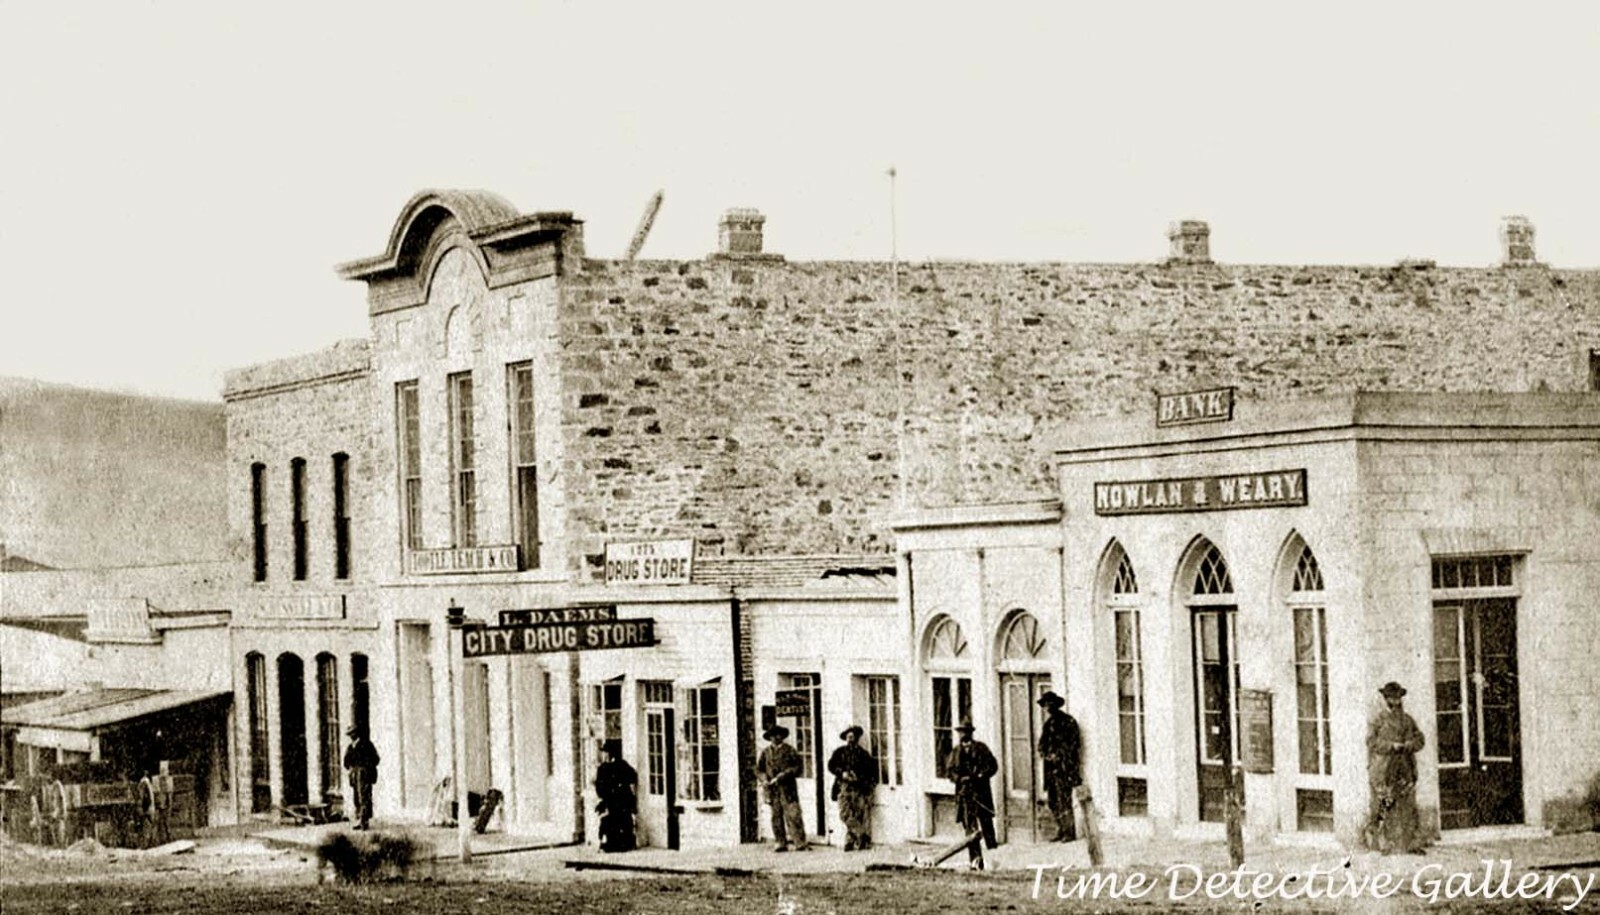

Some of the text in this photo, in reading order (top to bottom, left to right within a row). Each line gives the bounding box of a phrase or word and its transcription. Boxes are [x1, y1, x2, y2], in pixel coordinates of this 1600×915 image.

[1097, 482, 1182, 509] NOWLAN
[1194, 482, 1206, 504] &
[607, 558, 687, 581] DRUG STORE
[503, 613, 522, 625] L.
[465, 623, 649, 654] CITY DRUG STORE
